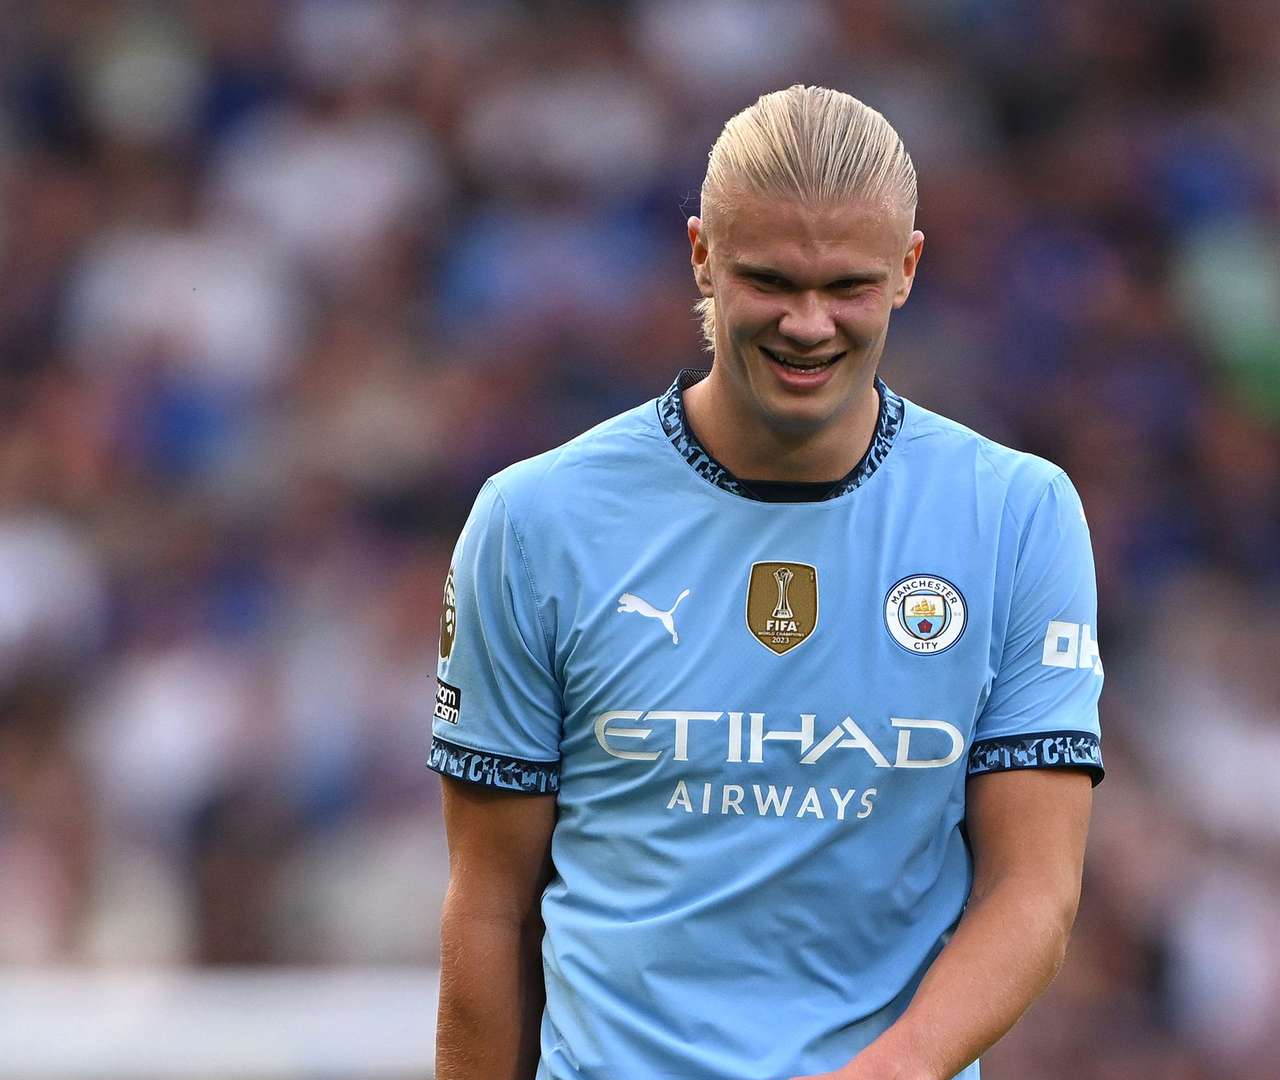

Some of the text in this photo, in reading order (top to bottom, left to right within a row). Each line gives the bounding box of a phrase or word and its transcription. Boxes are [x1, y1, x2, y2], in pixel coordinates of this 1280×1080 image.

[891, 580, 958, 605] MANCHESTER
[766, 620, 798, 632] FIFA
[913, 641, 938, 650] CITY
[594, 710, 965, 769] ETIHAD
[666, 780, 877, 820] AIRWAYS
